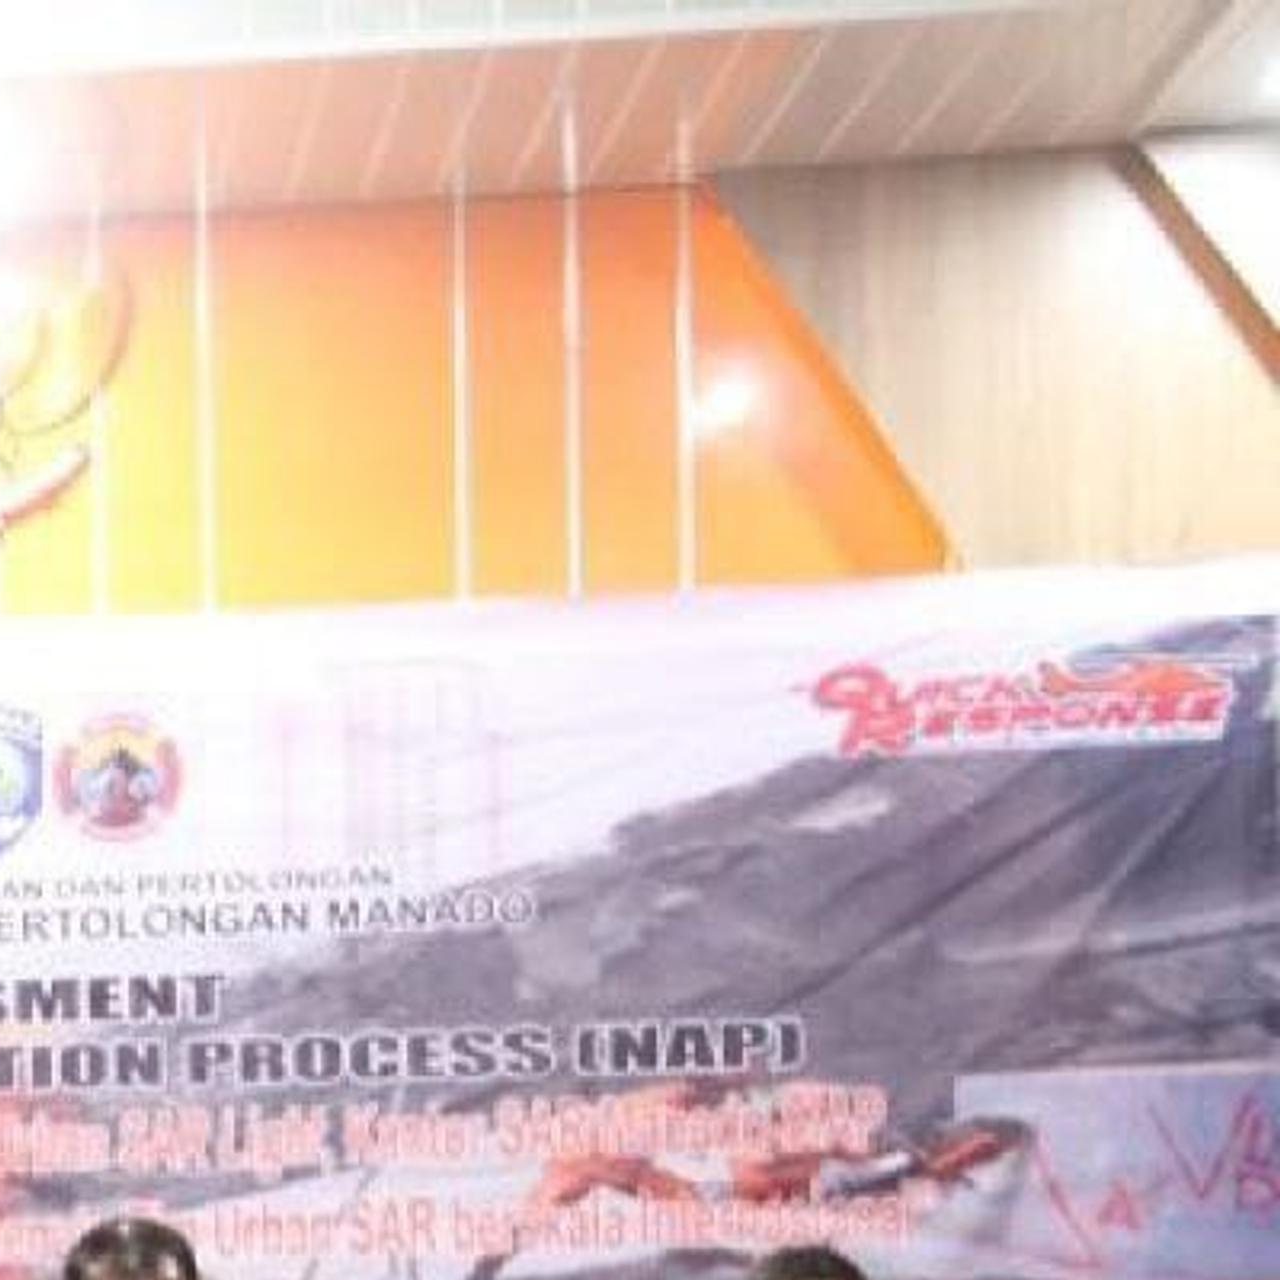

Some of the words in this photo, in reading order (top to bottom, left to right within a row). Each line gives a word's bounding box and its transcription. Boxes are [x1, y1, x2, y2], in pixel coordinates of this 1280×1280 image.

[55, 873, 125, 898] DAN
[138, 863, 394, 897] PERTOLONGAN
[326, 890, 537, 932] MANADO
[188, 1023, 553, 1083] PROCESS
[575, 1017, 802, 1071] (NAP)
[348, 1196, 445, 1256] SAR
